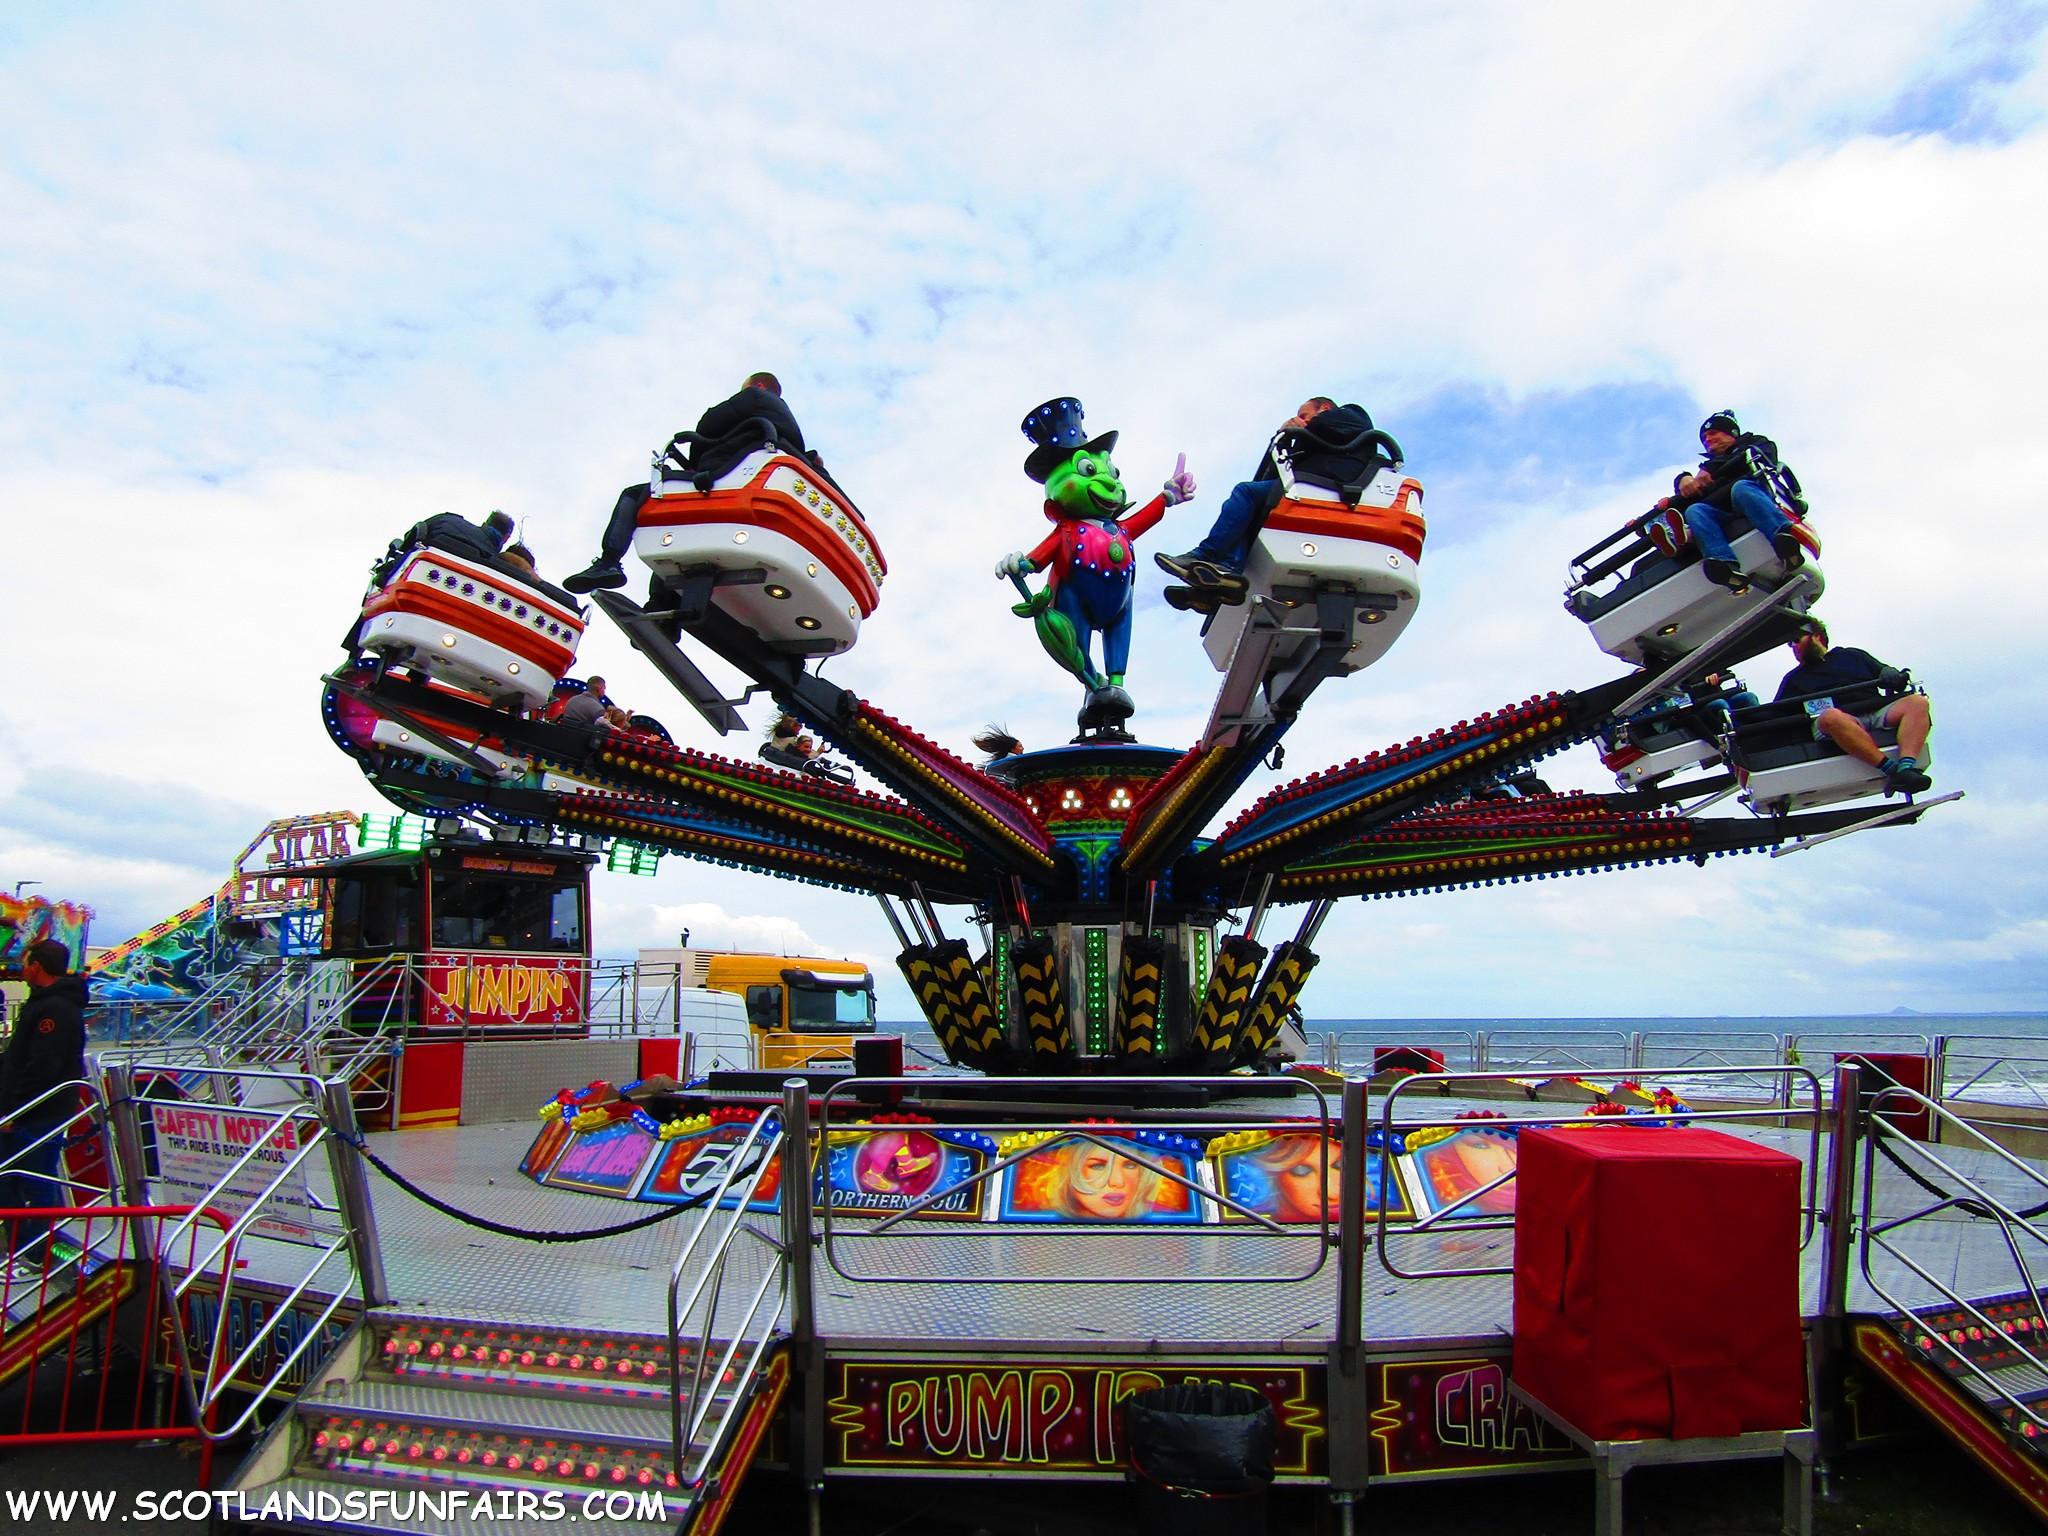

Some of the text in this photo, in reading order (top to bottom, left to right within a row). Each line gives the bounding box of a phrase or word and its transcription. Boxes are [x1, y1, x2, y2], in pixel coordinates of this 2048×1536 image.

[266, 824, 351, 864] STAR
[439, 963, 568, 1016] JUMPIN'
[313, 1015, 339, 1026] HRE
[155, 1107, 298, 1151] SAFETY NOTICE
[734, 1136, 771, 1146] STDIO
[168, 1136, 288, 1164] THIS RIDE IS BOISTROUS.
[163, 1175, 189, 1186] Children
[816, 1186, 914, 1209] NORTHERN
[188, 1294, 245, 1366] JUP
[888, 1369, 1074, 1464] PUMP
